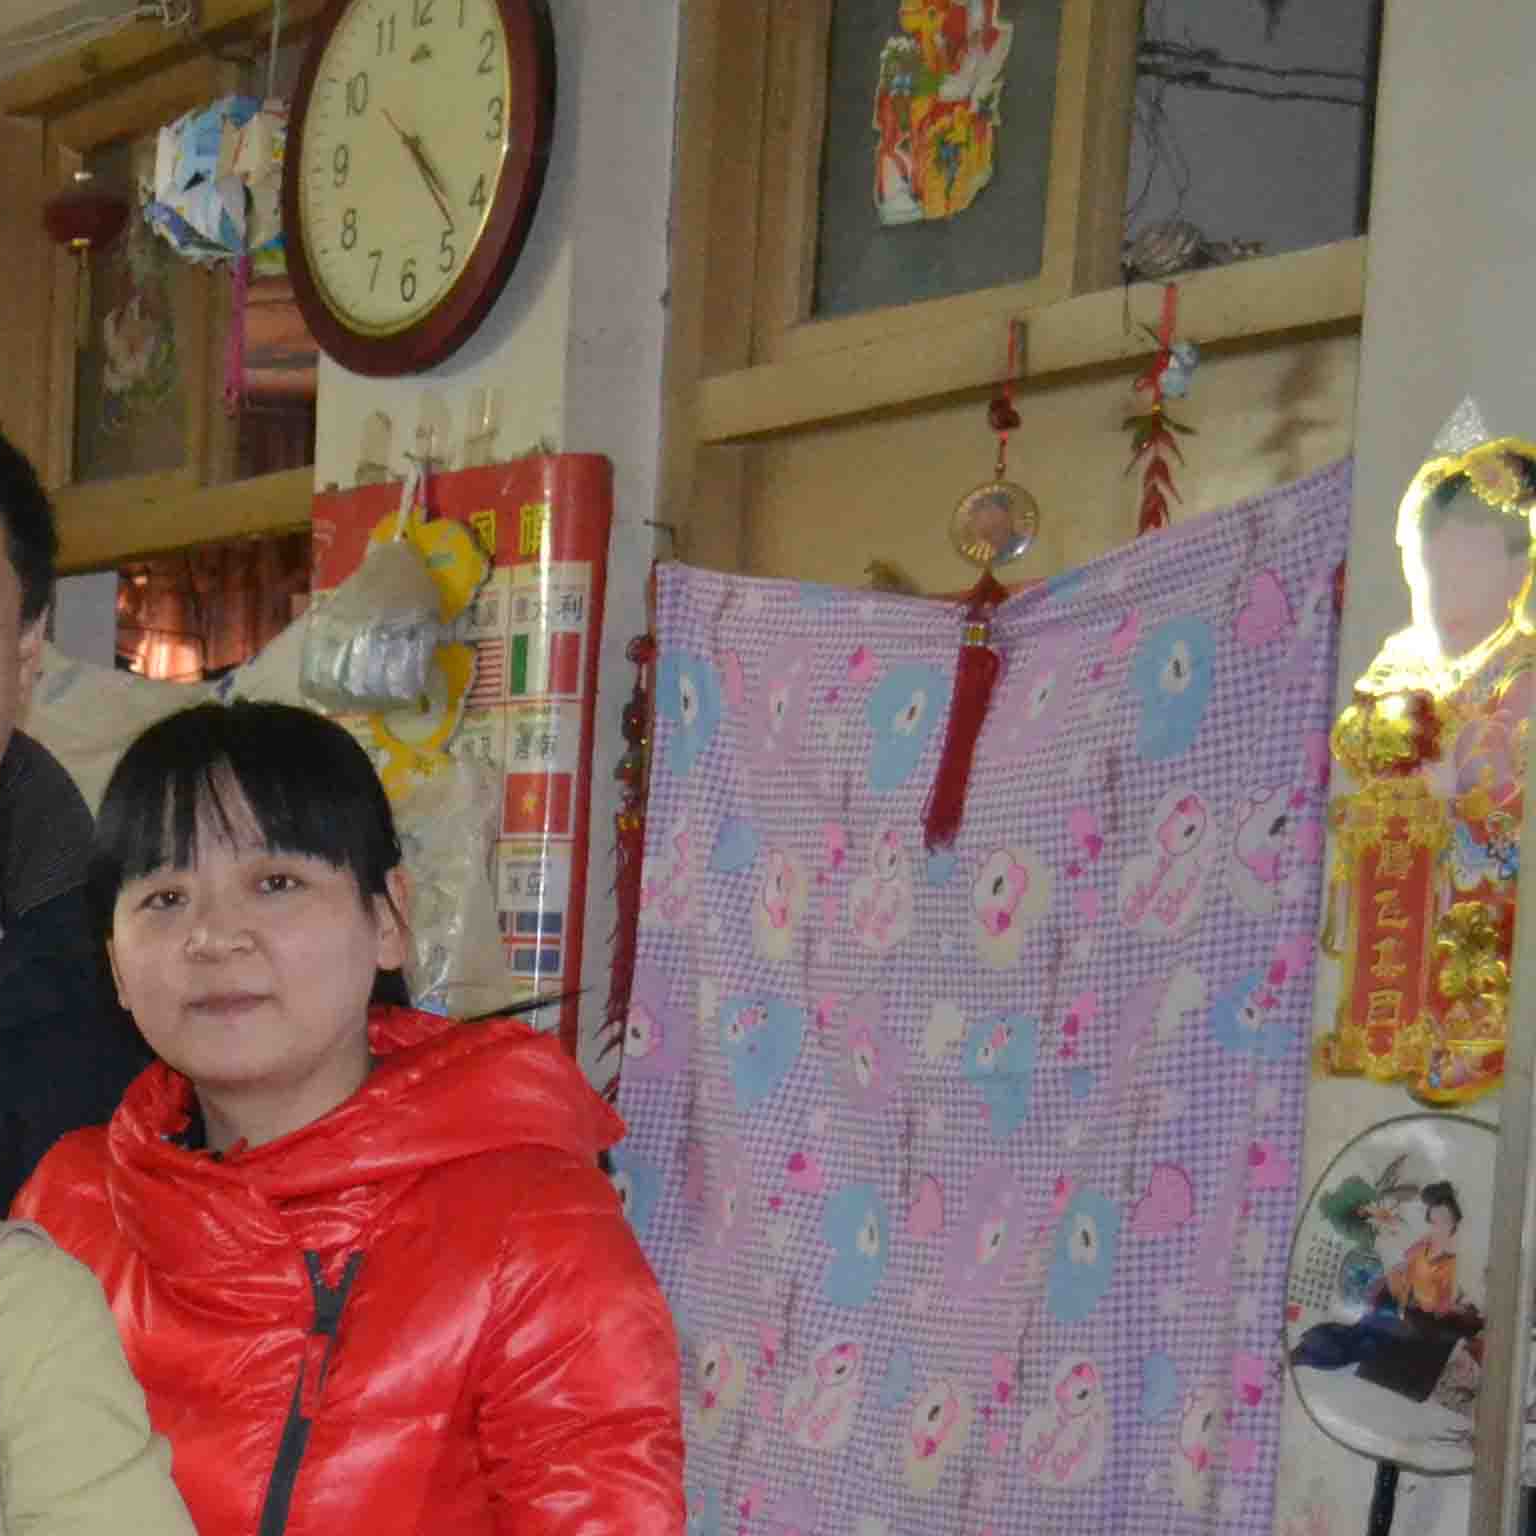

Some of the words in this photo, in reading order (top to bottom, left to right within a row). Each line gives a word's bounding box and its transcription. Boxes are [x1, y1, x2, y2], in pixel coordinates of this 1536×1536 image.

[376, 13, 396, 56] 11
[478, 30, 496, 75] 2
[346, 71, 369, 117] 10
[485, 96, 505, 141] 3
[333, 144, 349, 189] 9
[468, 174, 486, 212] 4
[340, 208, 357, 251] 8
[439, 225, 455, 273] 5
[367, 249, 382, 293] 7
[399, 257, 417, 303] 6
